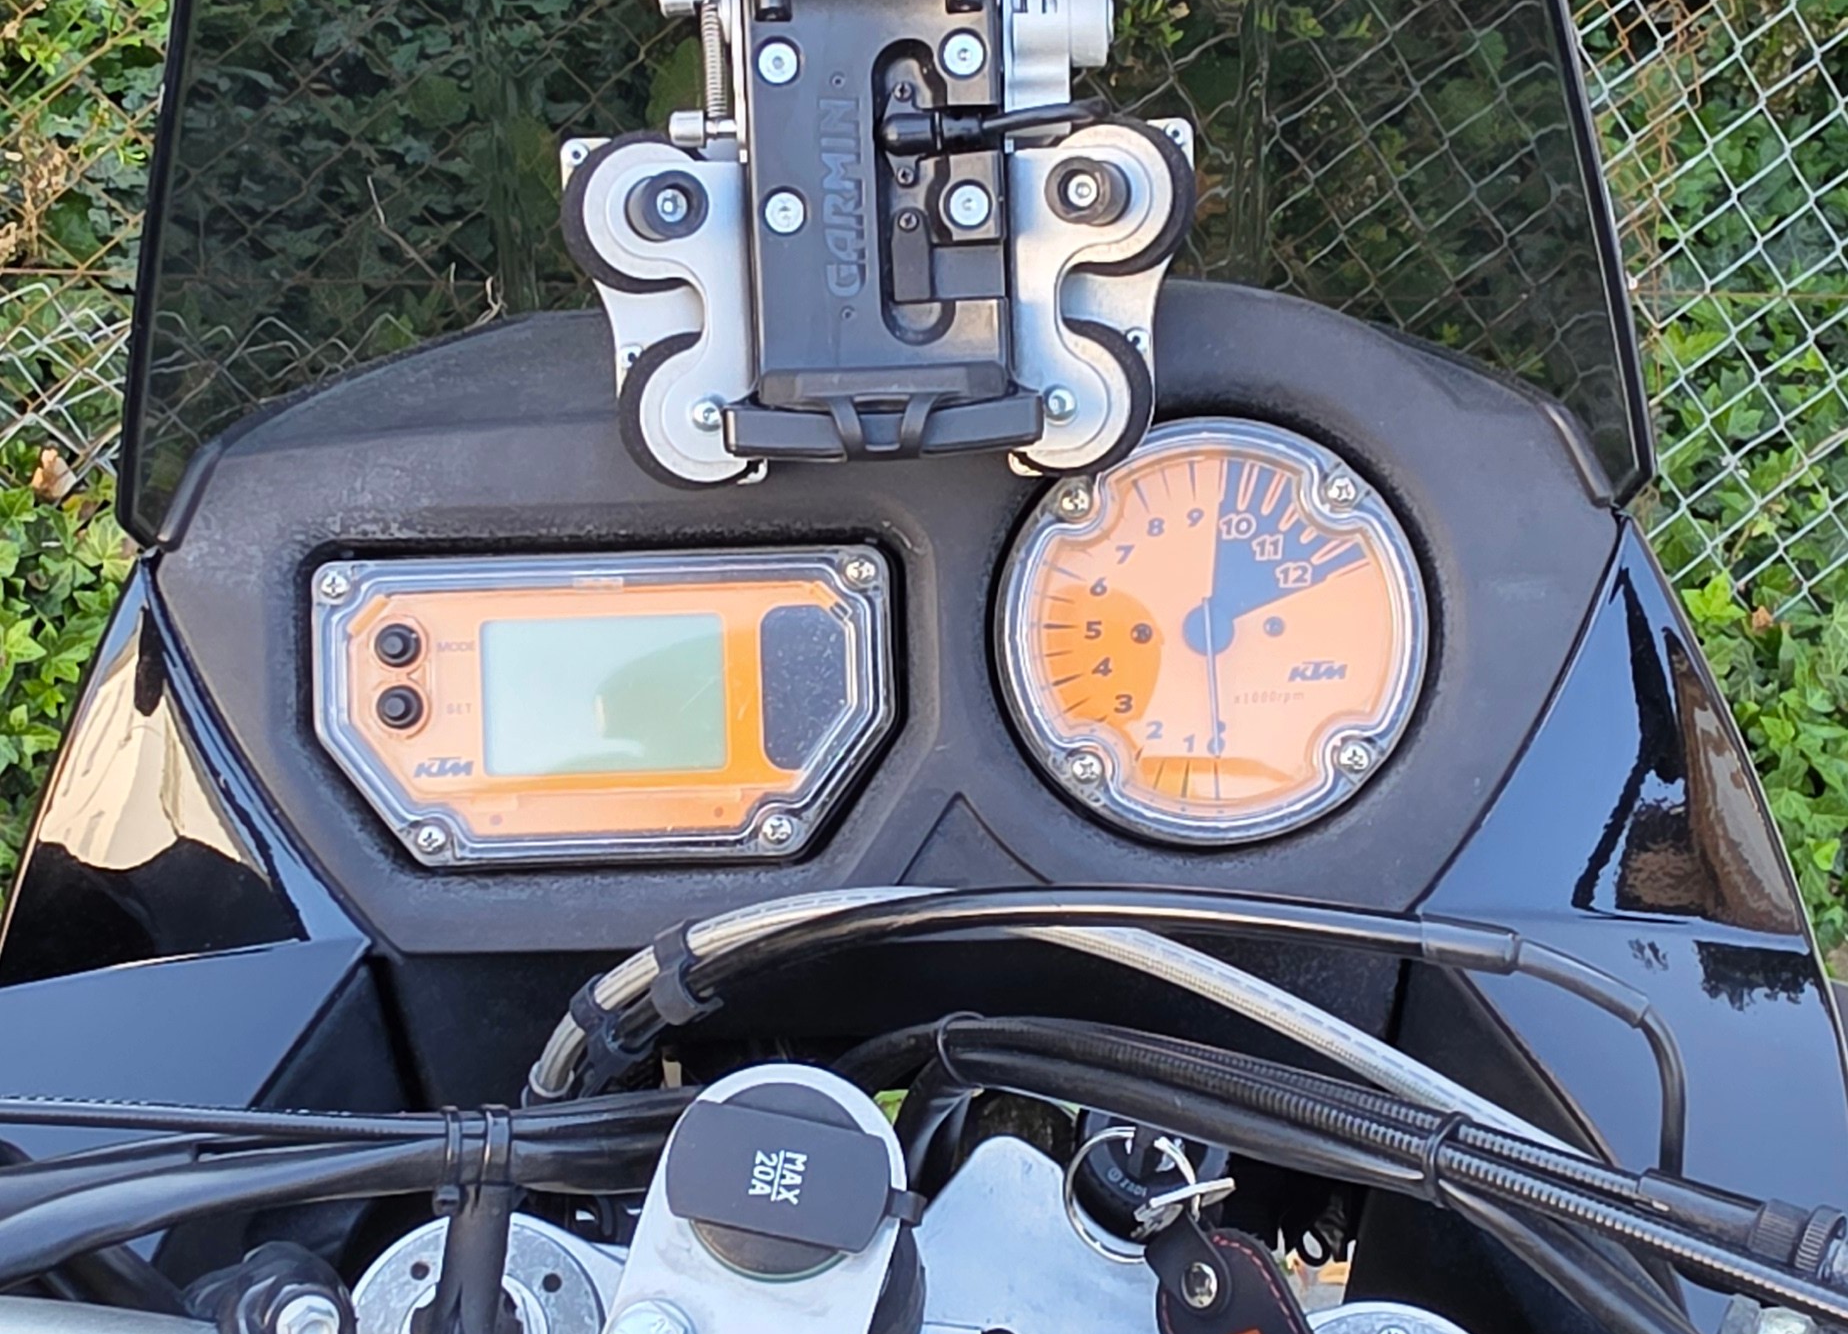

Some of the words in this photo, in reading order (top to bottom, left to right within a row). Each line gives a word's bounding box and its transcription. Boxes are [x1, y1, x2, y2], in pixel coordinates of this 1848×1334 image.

[818, 97, 863, 299] GARMIN
[1147, 518, 1165, 537] 8
[1186, 508, 1205, 528] 9
[1220, 514, 1255, 539] 10
[1115, 544, 1135, 564] 7
[1253, 534, 1283, 559] 11
[1276, 563, 1312, 588] 12
[1090, 577, 1108, 597] 6
[1084, 621, 1102, 639] 5
[436, 640, 475, 653] MODE
[1091, 657, 1112, 677] 4
[1288, 660, 1348, 682] KTM
[446, 702, 473, 715] SET
[1114, 694, 1133, 713] 3
[1145, 721, 1163, 740] 2
[1183, 734, 1195, 752] 1
[413, 756, 475, 778] KTM
[748, 1150, 779, 1197] 20A
[779, 1150, 808, 1205] MAX
